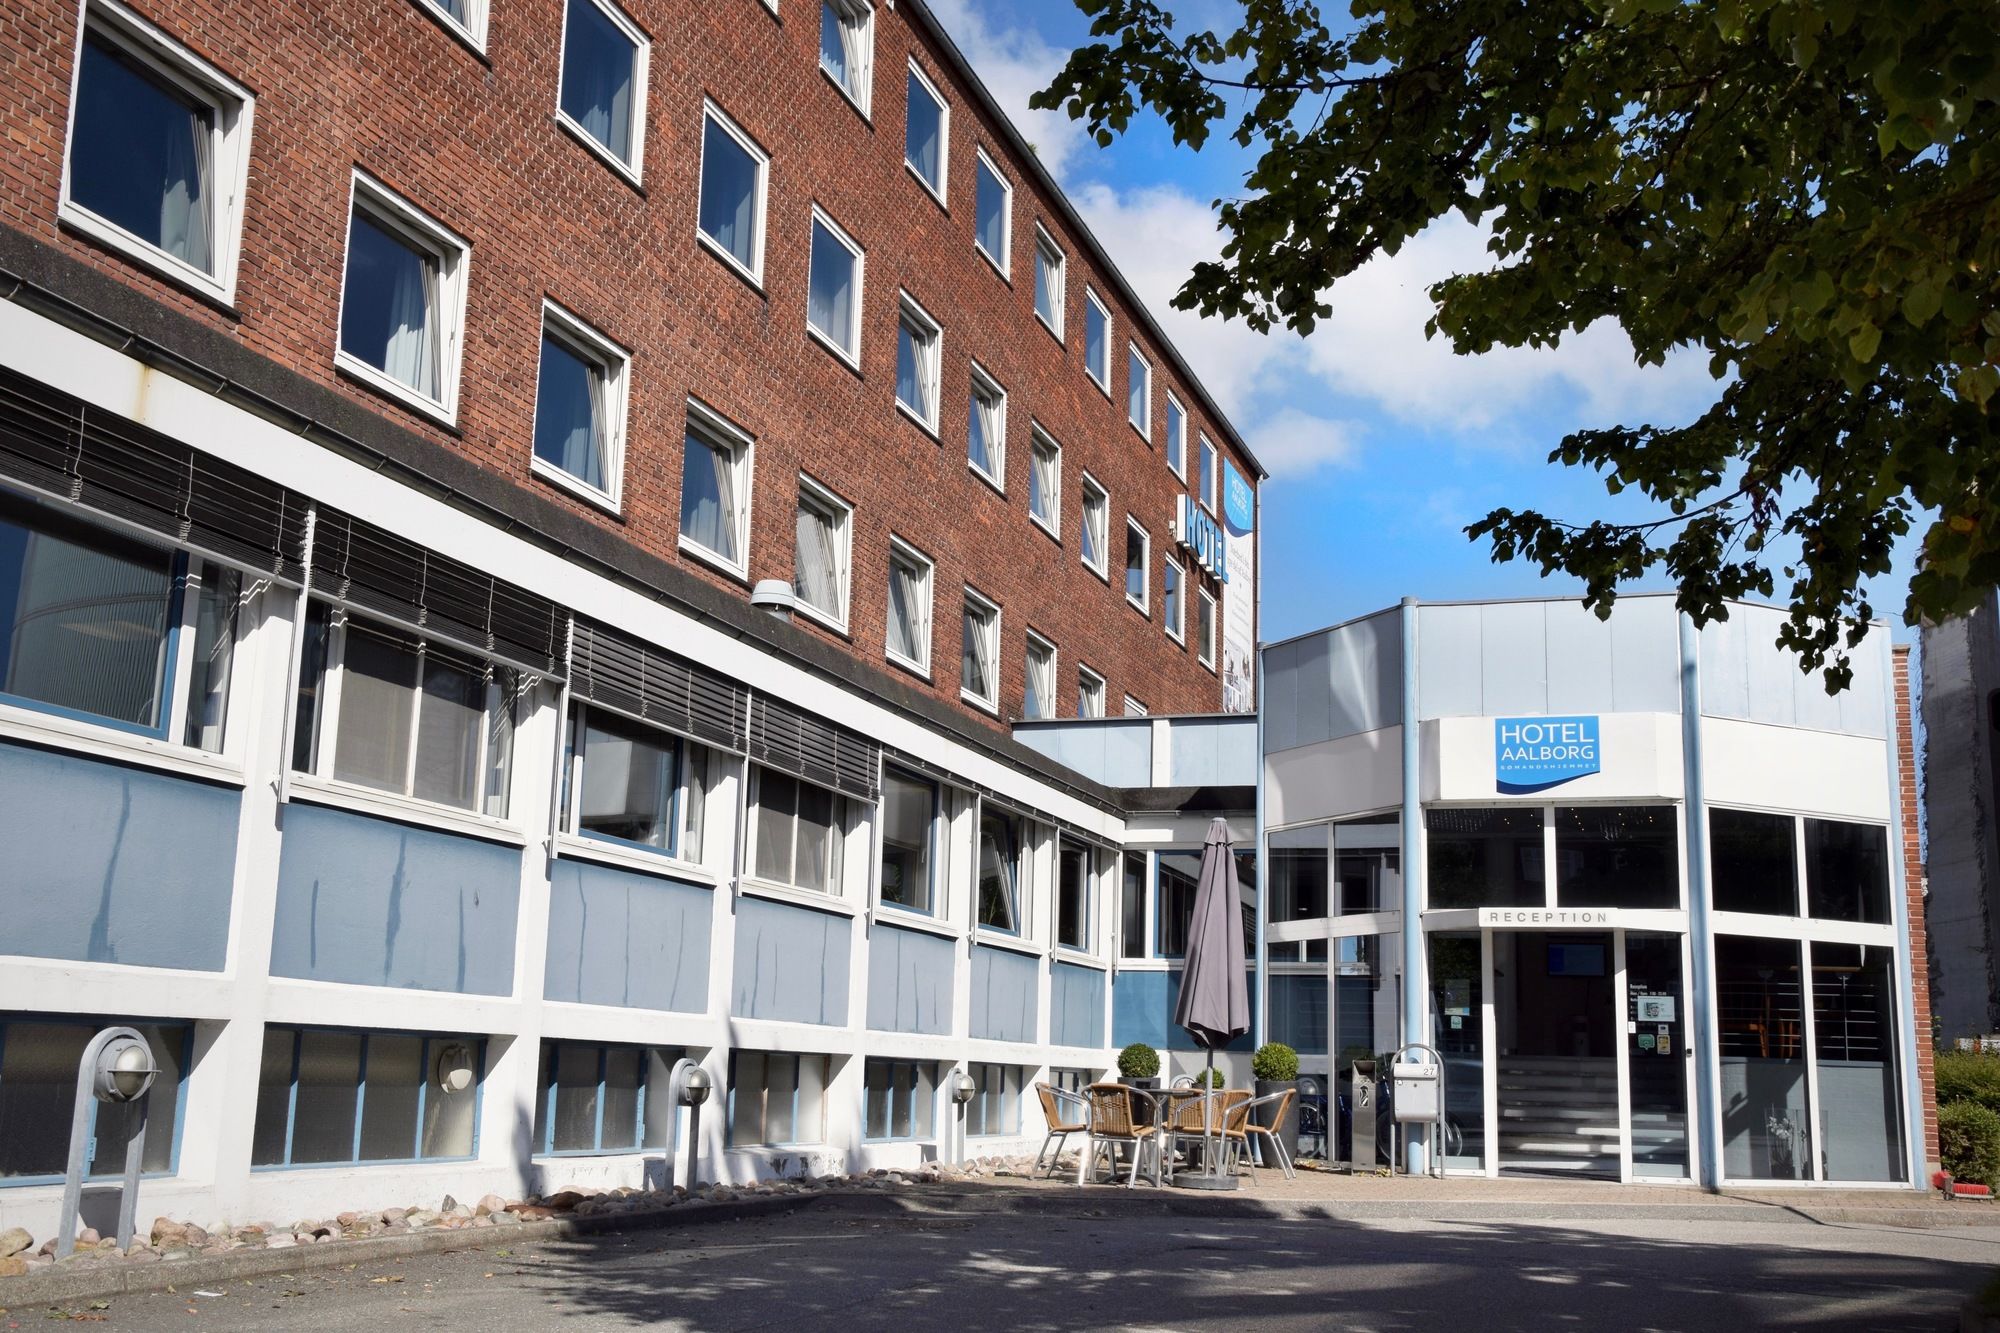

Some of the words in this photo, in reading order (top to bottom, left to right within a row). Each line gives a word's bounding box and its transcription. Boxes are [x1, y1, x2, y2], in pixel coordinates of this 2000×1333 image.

[1185, 494, 1229, 584] HOTEL
[1501, 723, 1594, 744] HOTEL
[1501, 745, 1594, 761] AALBORG
[1490, 912, 1606, 922] RECEPTION
[1423, 1067, 1435, 1076] 27
